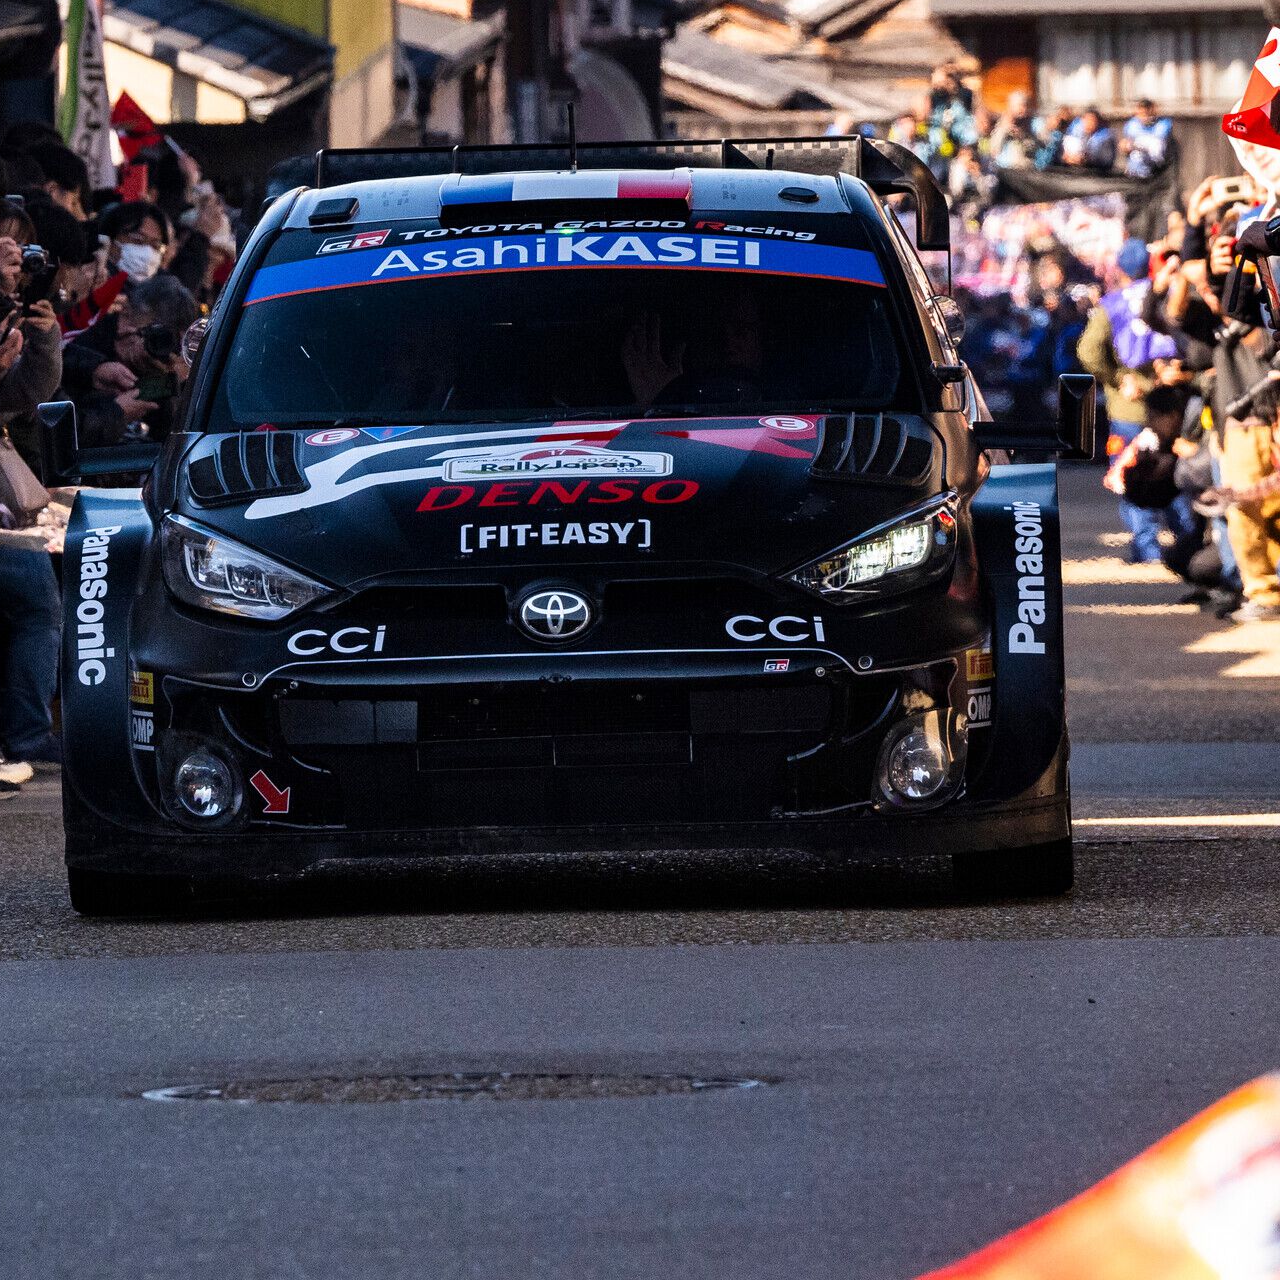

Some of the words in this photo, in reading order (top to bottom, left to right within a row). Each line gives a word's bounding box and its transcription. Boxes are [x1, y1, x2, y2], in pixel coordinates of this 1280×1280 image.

[318, 231, 388, 254] GR
[398, 222, 543, 240] TOYOTA
[554, 220, 686, 230] GAZOO
[695, 221, 816, 241] Racing
[415, 480, 701, 513] DENSO
[1003, 501, 1046, 655] Panasonic
[76, 525, 122, 686] Panasonic
[765, 661, 788, 671] GR
[132, 716, 154, 744] OMP
